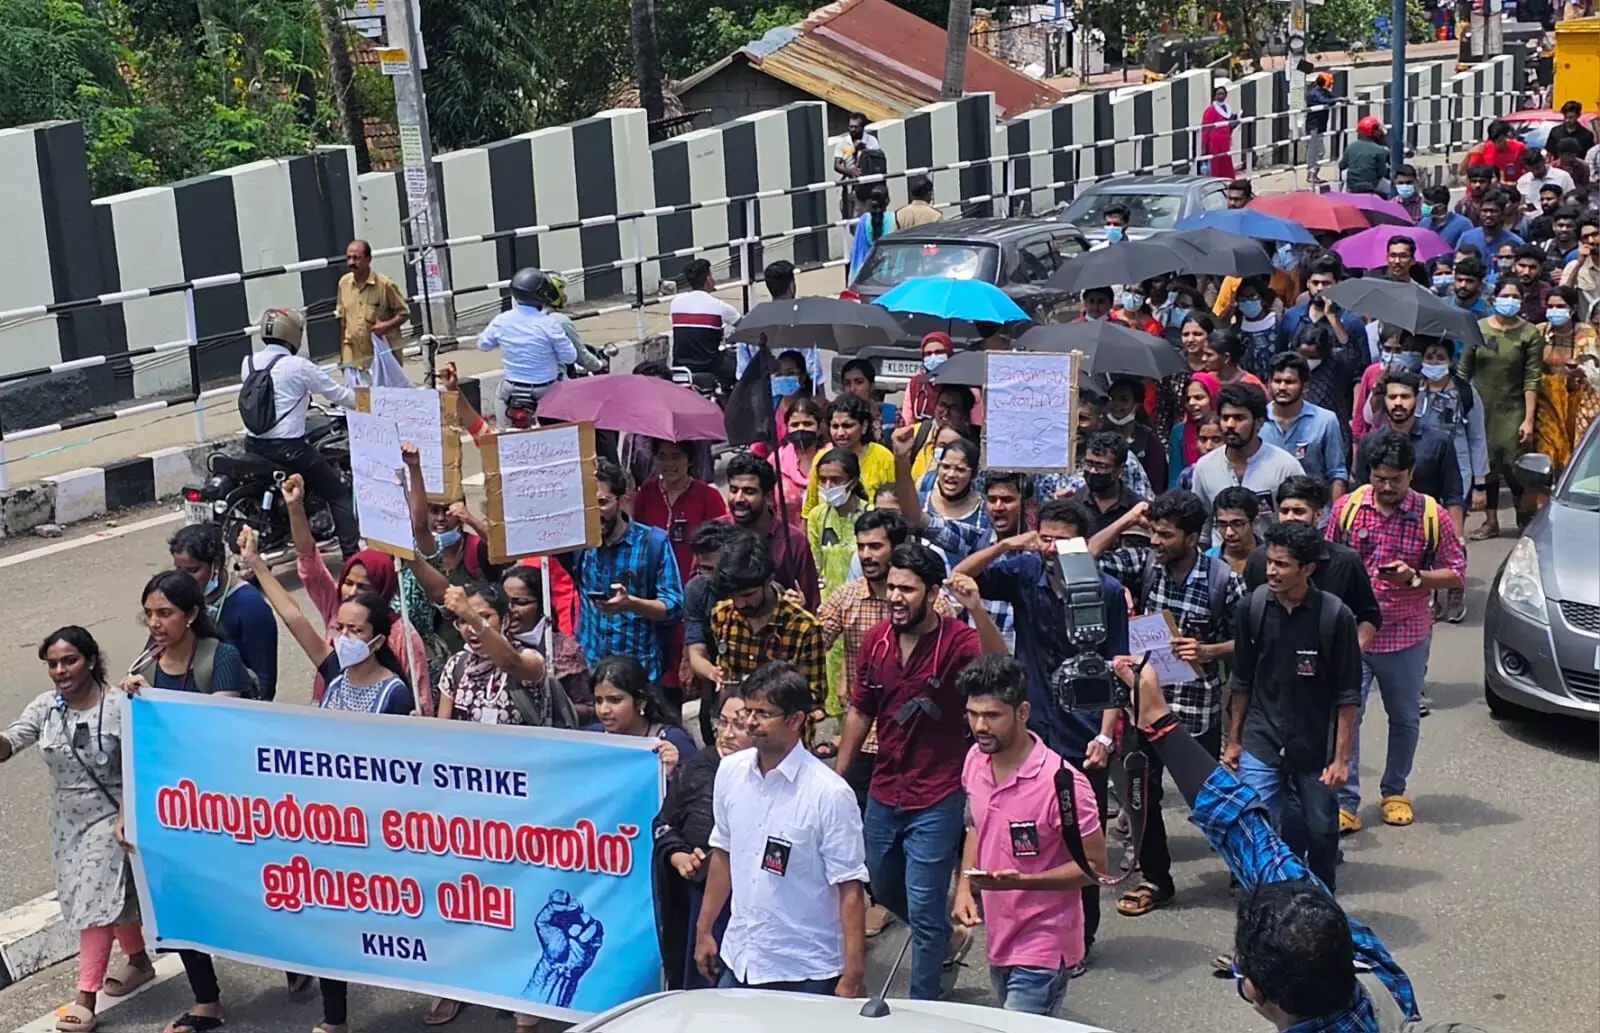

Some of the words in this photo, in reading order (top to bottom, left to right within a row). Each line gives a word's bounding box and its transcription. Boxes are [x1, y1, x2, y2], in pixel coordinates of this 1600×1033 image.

[256, 746, 423, 785] EMERGENCY
[433, 763, 528, 797] STRIKE
[1061, 789, 1072, 812] EOS
[1132, 777, 1142, 810] Canon
[381, 809, 638, 874] സേവനത്തിന്
[262, 855, 423, 917] ജീവനോ
[437, 872, 514, 929] വില
[362, 933, 426, 961] KHSA
